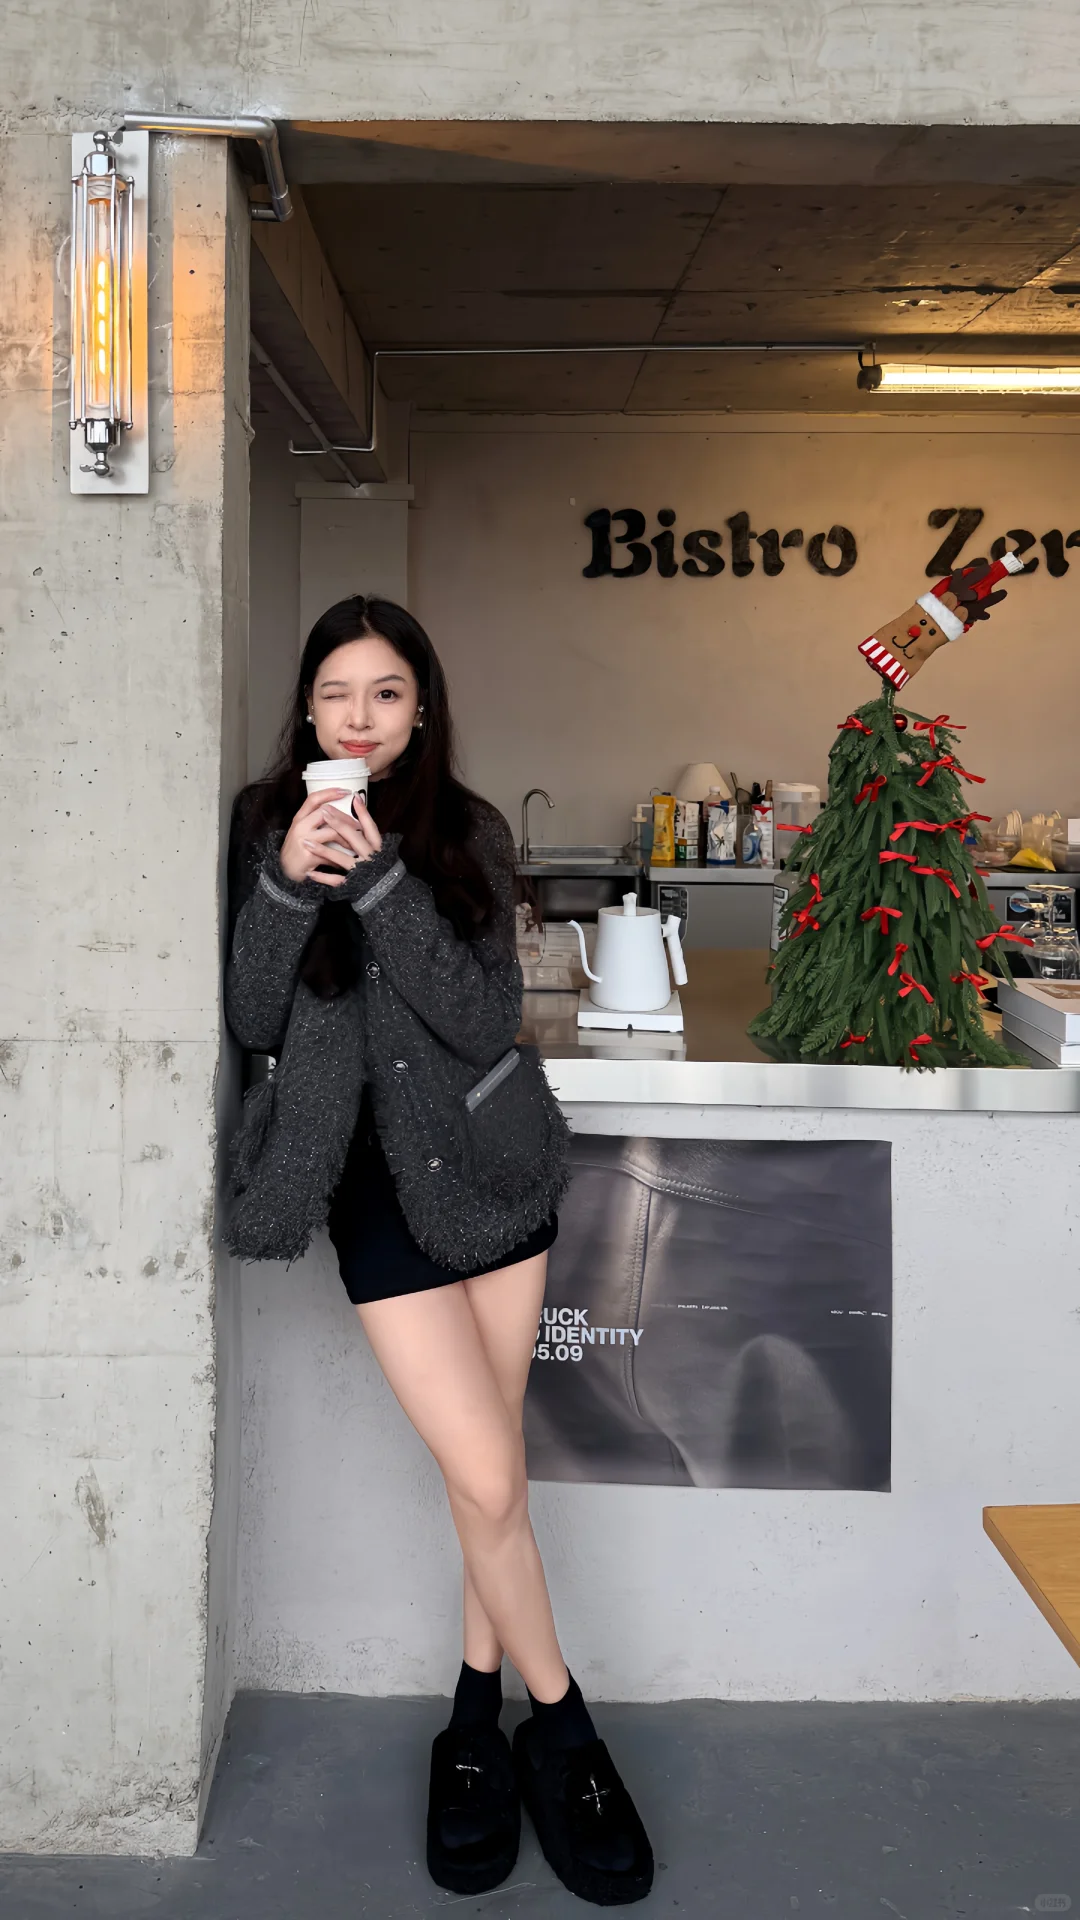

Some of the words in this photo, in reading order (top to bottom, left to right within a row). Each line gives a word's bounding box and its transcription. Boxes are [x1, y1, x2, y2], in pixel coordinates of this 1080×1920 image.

[583, 507, 858, 577] Bistro
[539, 1307, 588, 1325] UCK
[545, 1325, 643, 1346] IDENTITY
[532, 1344, 583, 1361] 5.09
